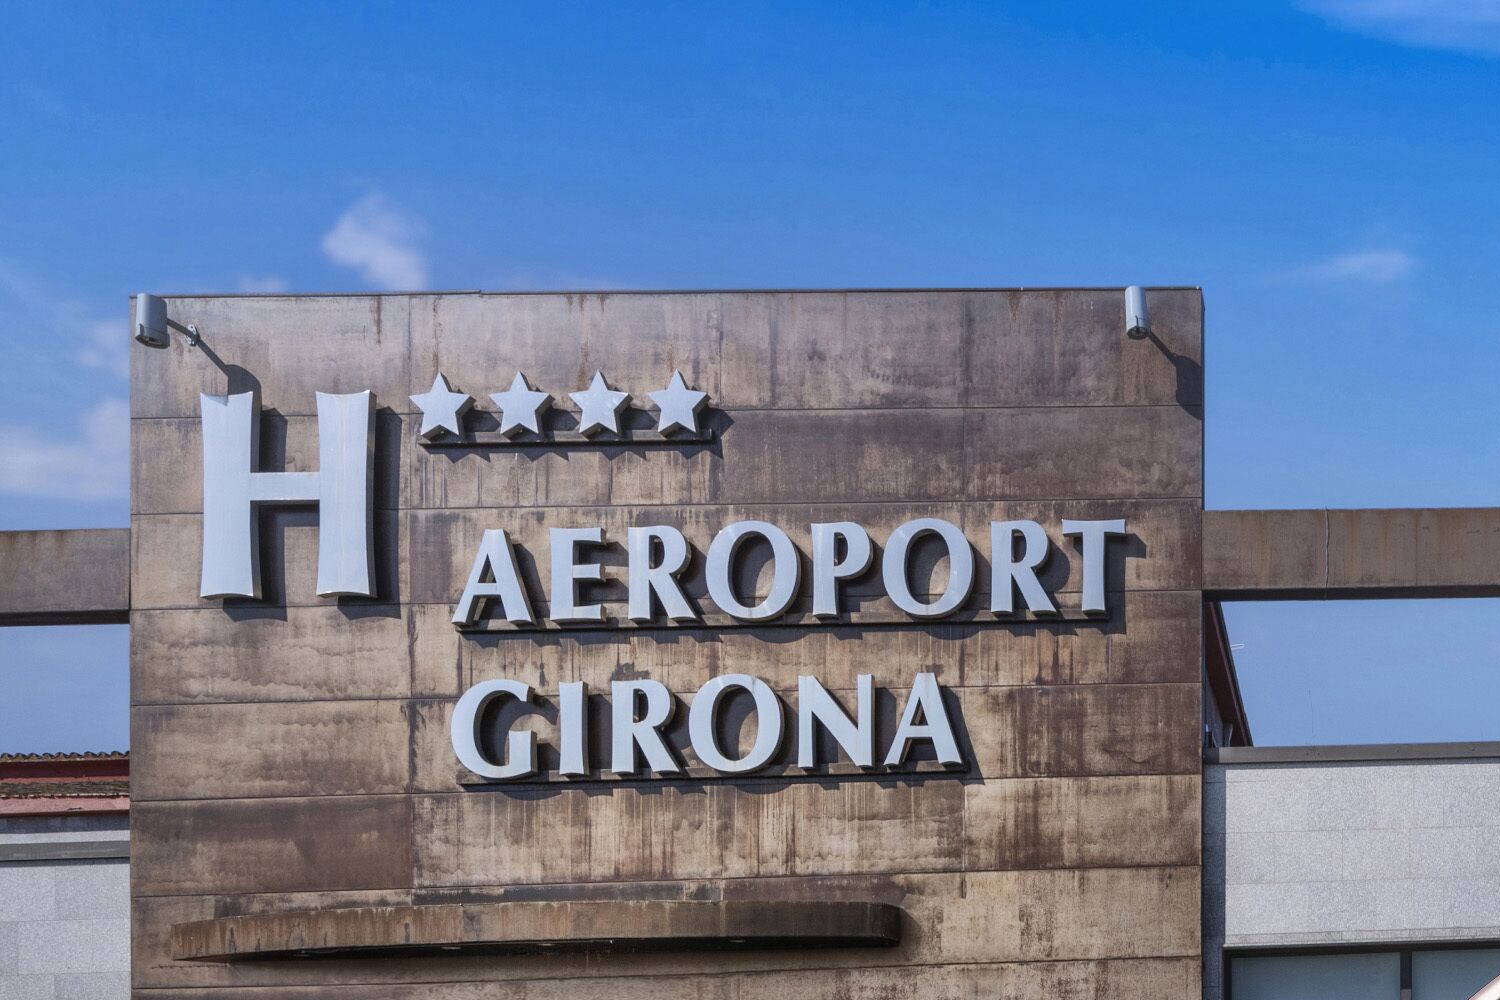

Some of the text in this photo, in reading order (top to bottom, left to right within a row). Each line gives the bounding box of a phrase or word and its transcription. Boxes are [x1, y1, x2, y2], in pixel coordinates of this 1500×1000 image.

[198, 387, 376, 599] H
[452, 516, 1128, 626] AEROPORT
[449, 671, 965, 780] GIRONA
